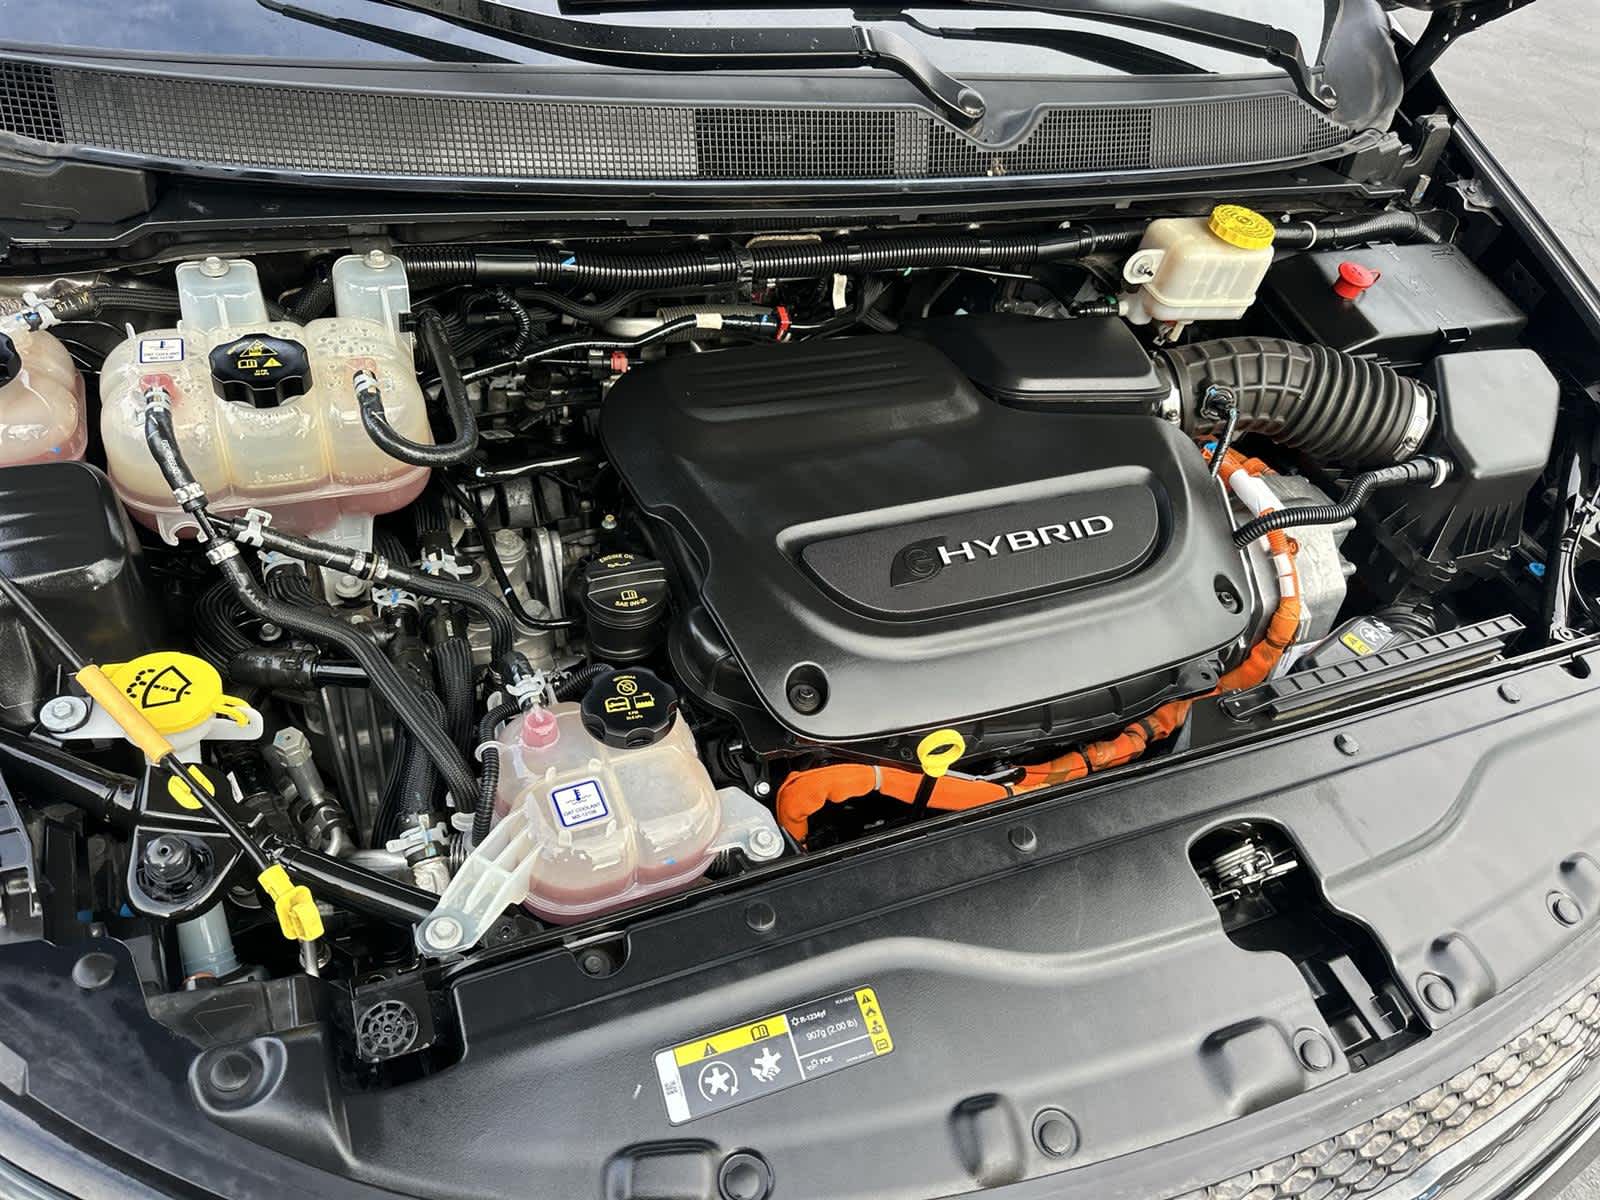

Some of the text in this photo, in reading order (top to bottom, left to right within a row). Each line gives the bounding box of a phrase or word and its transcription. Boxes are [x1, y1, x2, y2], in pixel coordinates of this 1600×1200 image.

[937, 515, 1114, 565] HYBRID
[599, 553, 622, 563] ENGINE
[805, 1018, 858, 1041] 907g (2.00 lb)
